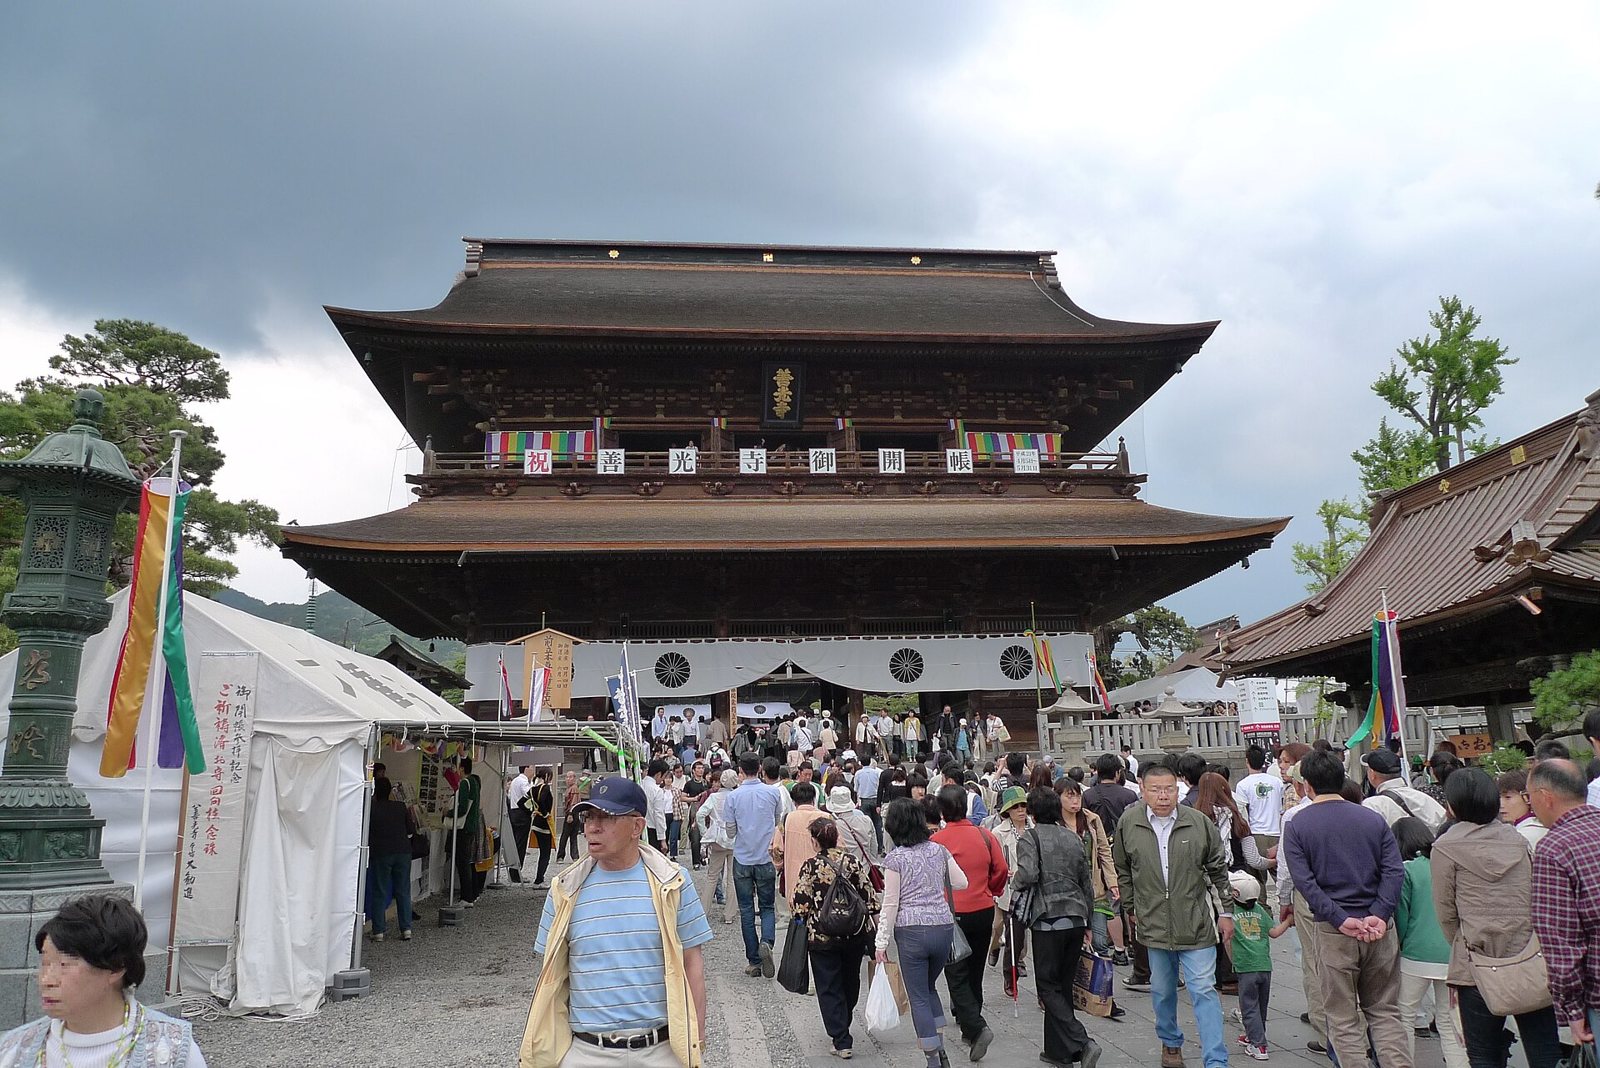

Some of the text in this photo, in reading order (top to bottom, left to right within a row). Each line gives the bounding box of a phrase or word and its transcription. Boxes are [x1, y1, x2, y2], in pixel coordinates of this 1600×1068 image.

[527, 450, 971, 473] 祝 善 光 寺 御 開 帳
